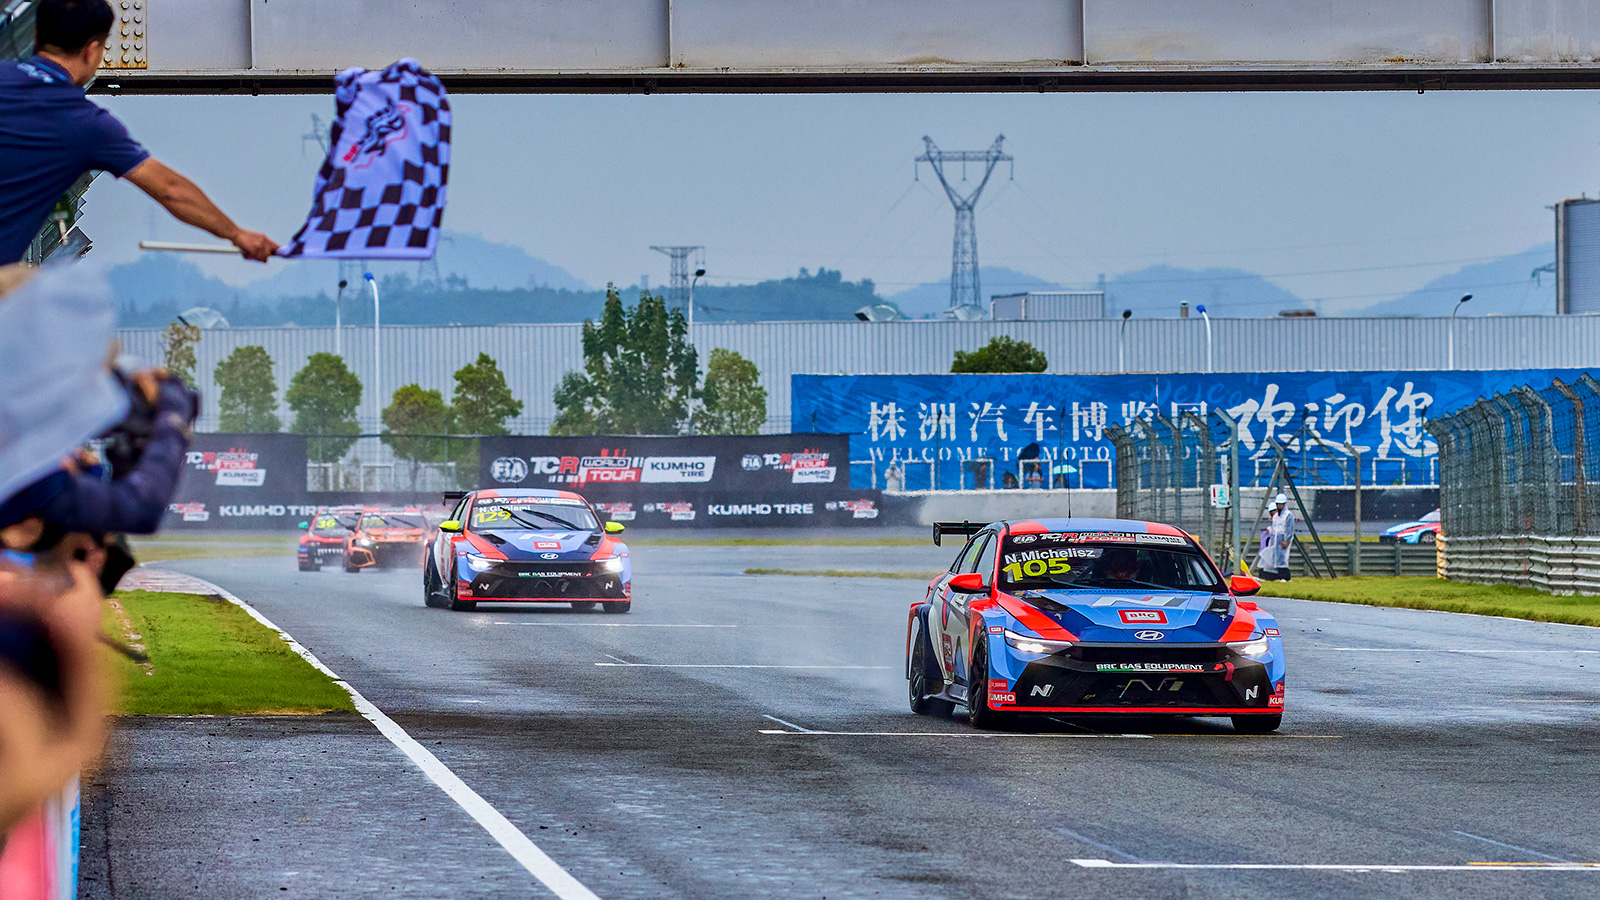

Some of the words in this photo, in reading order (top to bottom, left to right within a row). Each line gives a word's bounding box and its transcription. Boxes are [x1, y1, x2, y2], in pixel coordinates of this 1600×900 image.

[1216, 381, 1439, 460] 欢迎您
[186, 452, 216, 464] TCR
[869, 446, 988, 461] WELCOME
[1000, 446, 1024, 461] T
[1042, 446, 1110, 461] MOTO
[651, 462, 705, 470] KUMHO
[742, 456, 761, 469] FIA
[762, 453, 792, 466] TCR
[492, 460, 526, 479] FIA
[530, 456, 579, 474] TCR
[583, 457, 627, 467] WORLD
[589, 470, 636, 480] TOUR
[219, 505, 286, 516] KUMHO
[707, 504, 772, 515] KUMHO
[773, 503, 814, 515] TIRE
[473, 511, 512, 523] 129
[317, 519, 336, 528] 36
[1013, 535, 1036, 543] FIA
[1039, 532, 1079, 541] TCR
[1004, 548, 1095, 564] N.Michelisz
[1002, 557, 1071, 581] 105
[1120, 662, 1142, 670] GAS
